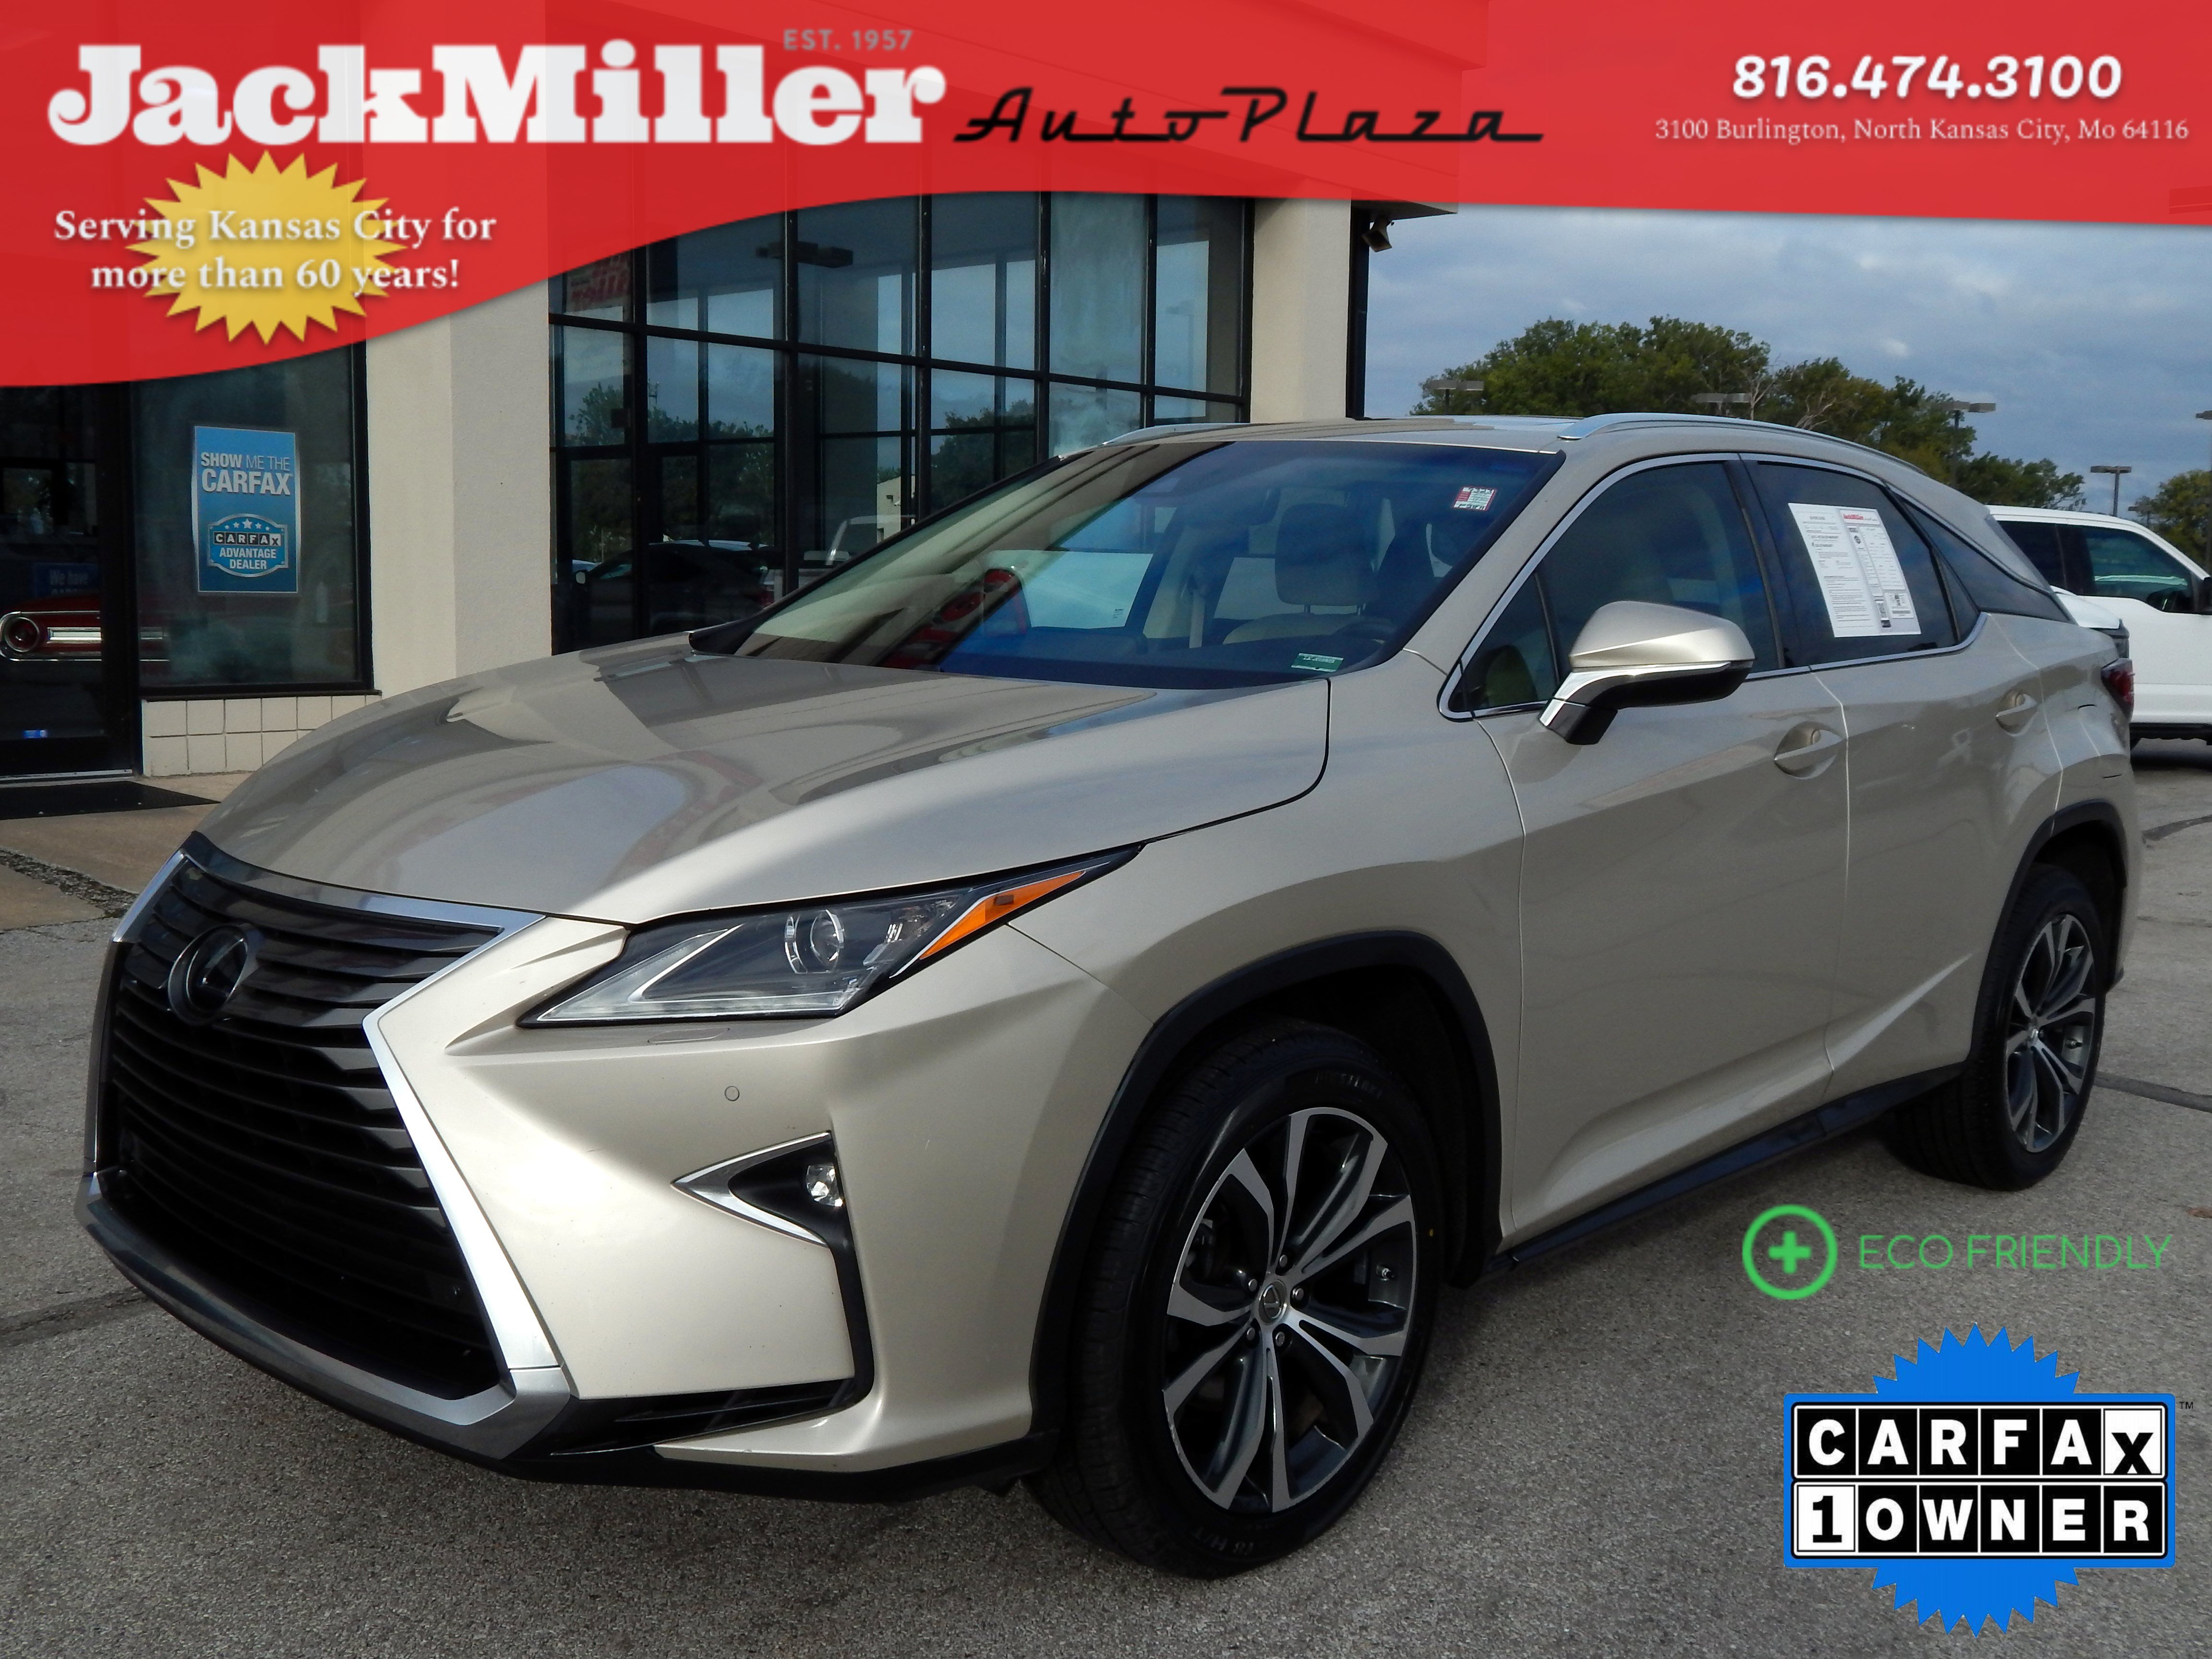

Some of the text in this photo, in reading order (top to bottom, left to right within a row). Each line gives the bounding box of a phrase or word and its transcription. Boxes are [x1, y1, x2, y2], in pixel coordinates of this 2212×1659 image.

[201, 452, 290, 471] SHOW ME THE
[202, 469, 290, 495] CARFAX
[216, 533, 280, 546] CARFAX
[219, 547, 276, 558] ADVANTAGE
[229, 559, 267, 569] DEALER
